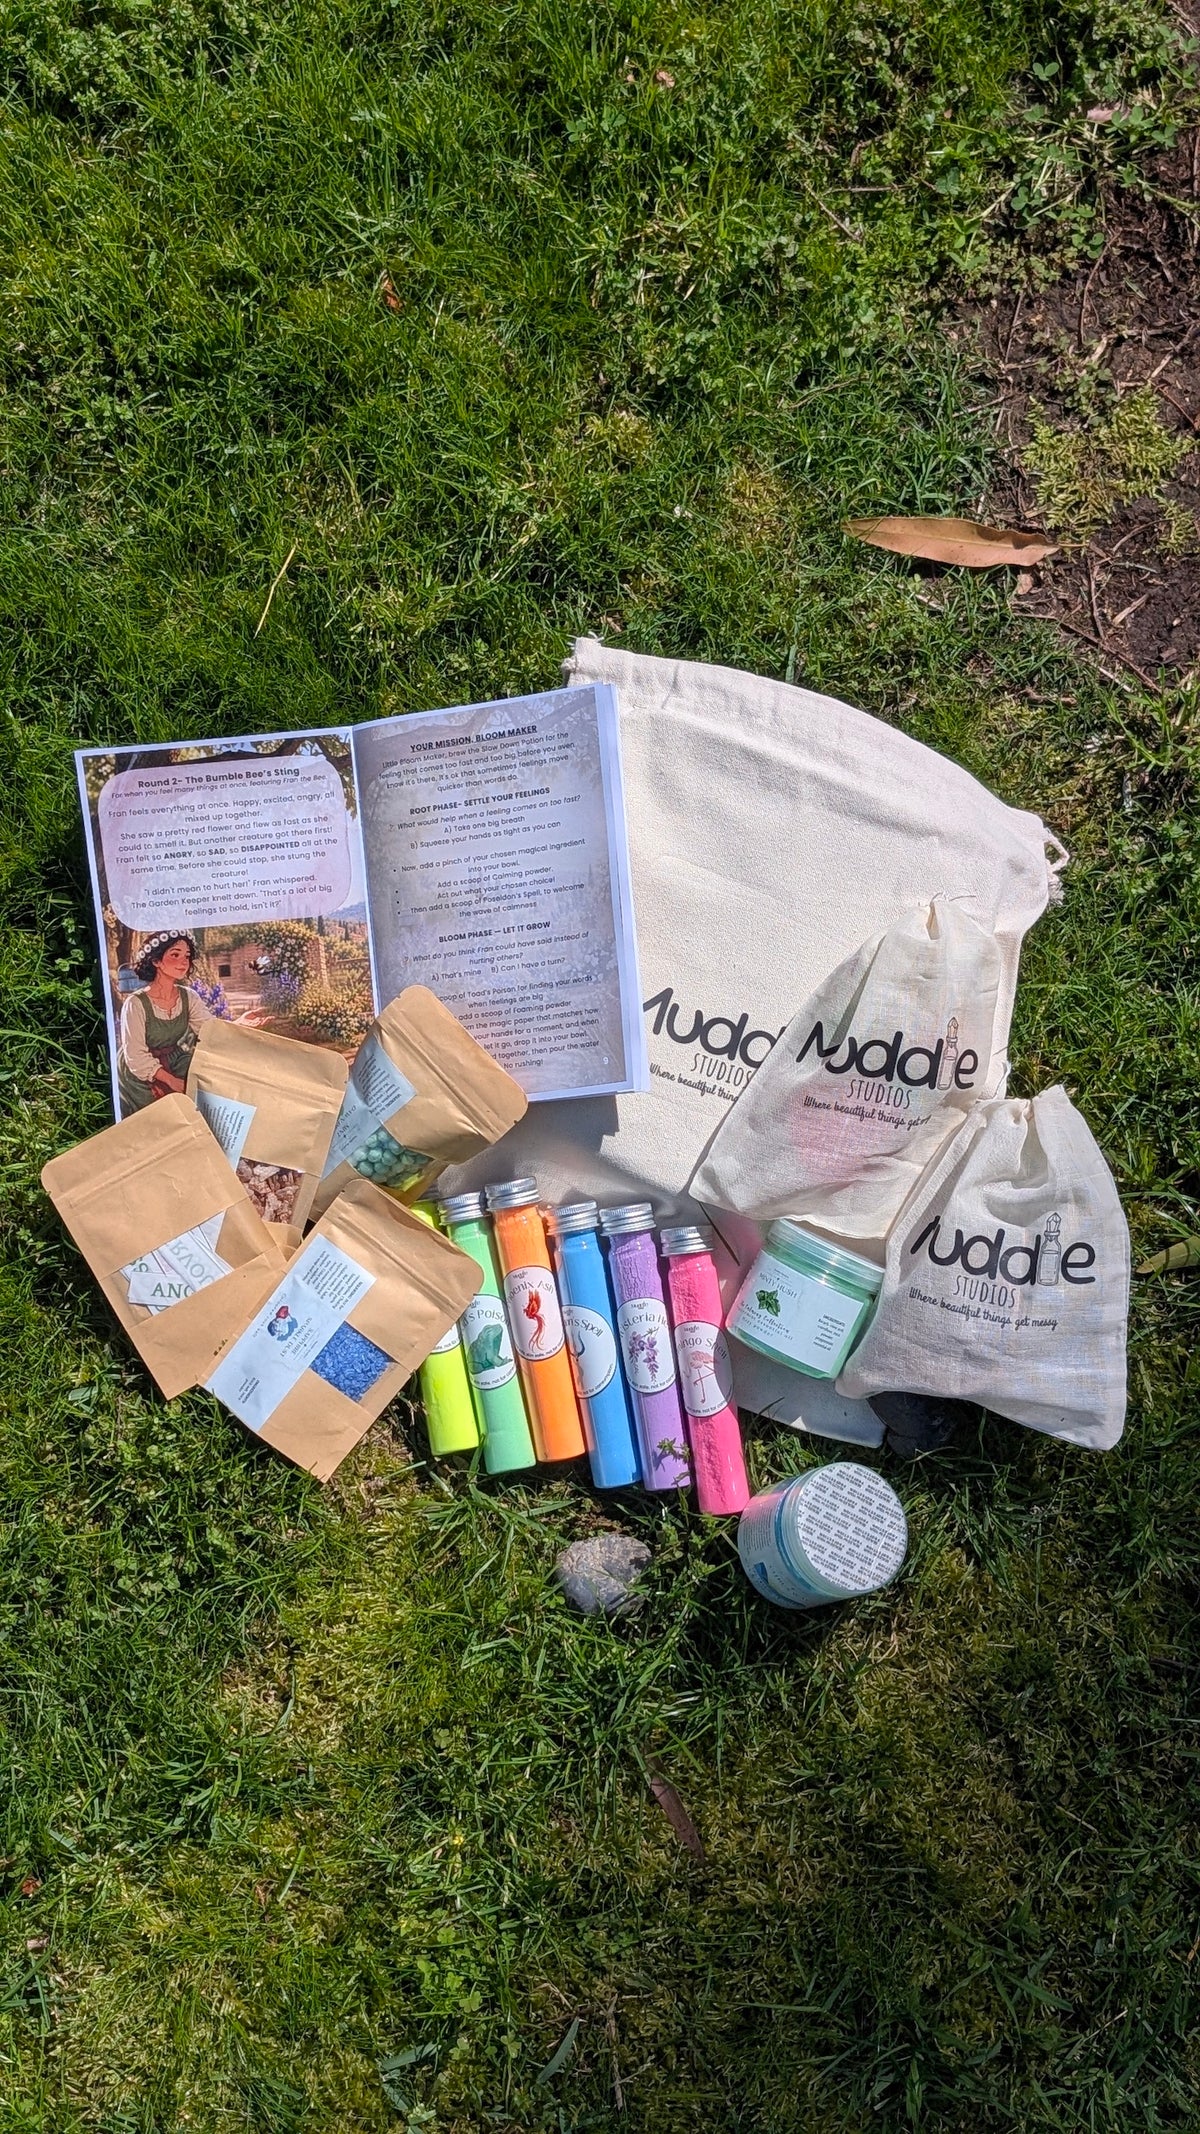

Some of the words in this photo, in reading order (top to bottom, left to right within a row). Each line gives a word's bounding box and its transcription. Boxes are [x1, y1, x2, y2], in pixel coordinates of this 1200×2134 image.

[409, 742, 433, 751] YOUR
[475, 731, 506, 741] BLOOM
[507, 726, 537, 736] MAKER
[137, 779, 169, 788] Round
[185, 776, 203, 784] The
[205, 772, 243, 782] Bumble
[245, 770, 271, 779] Bee's
[274, 767, 299, 777] Sting
[409, 806, 431, 815] ROOT
[463, 797, 489, 806] SETTLE
[491, 793, 513, 802] YOUR
[514, 787, 549, 798] FEELINGS
[439, 933, 466, 942] BLOOM
[467, 929, 492, 938] PHASE
[525, 921, 550, 930] GROW
[677, 1073, 717, 1096] beautiful
[691, 1053, 752, 1089] STUDIOS
[847, 1079, 912, 1109] STUDIOS
[803, 1095, 832, 1110] Where
[834, 1102, 875, 1121] beautiful
[877, 1110, 906, 1129] things
[953, 1275, 1016, 1309] STUDIOS
[909, 1286, 938, 1305] Where
[940, 1297, 981, 1321] beautiful
[983, 1309, 1012, 1329] things
[1015, 1317, 1030, 1331] get
[1031, 1319, 1058, 1331] messy
